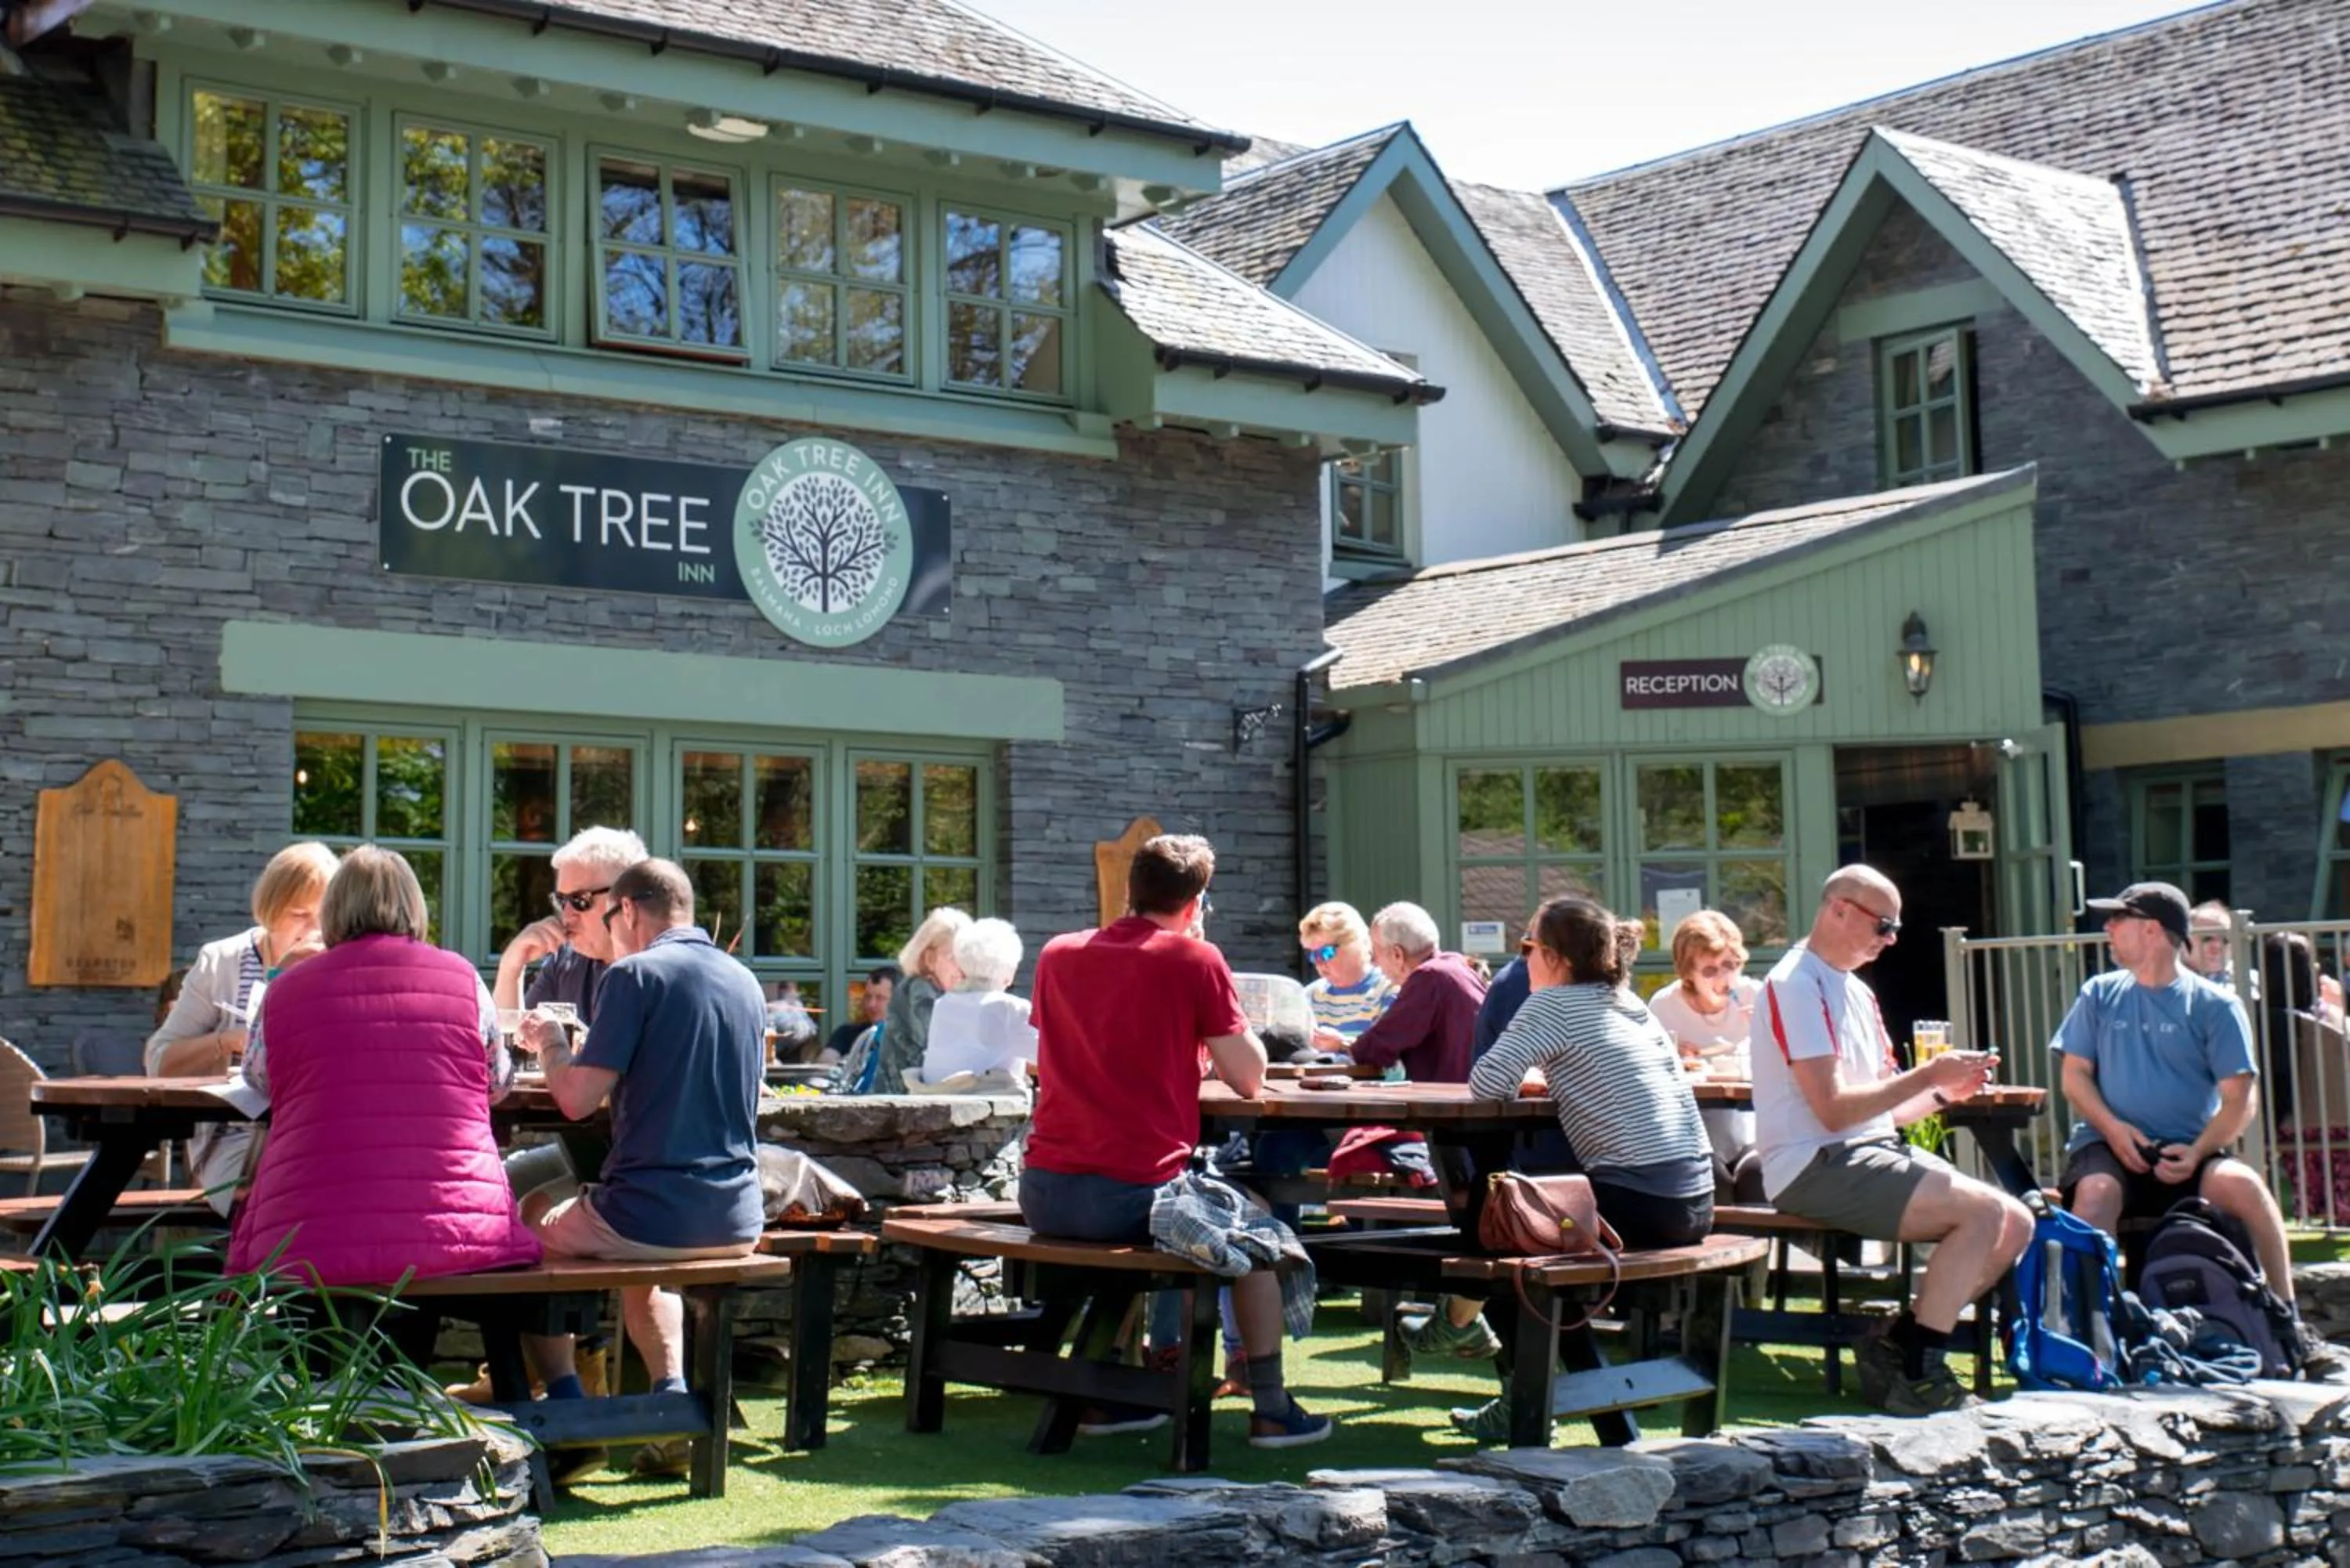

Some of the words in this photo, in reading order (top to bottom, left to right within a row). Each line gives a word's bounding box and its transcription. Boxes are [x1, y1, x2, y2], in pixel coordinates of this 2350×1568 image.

[407, 447, 452, 471] THE
[747, 457, 790, 509] OAK
[794, 444, 861, 476] TREE
[864, 471, 902, 523] INN
[400, 470, 543, 540] OAK
[559, 483, 711, 555] TREE
[678, 561, 715, 583] INN
[750, 566, 801, 628] BALMAHA
[814, 623, 854, 636] LOCH
[857, 576, 898, 628] LOMOND
[1625, 674, 1738, 694] RECEPTION
